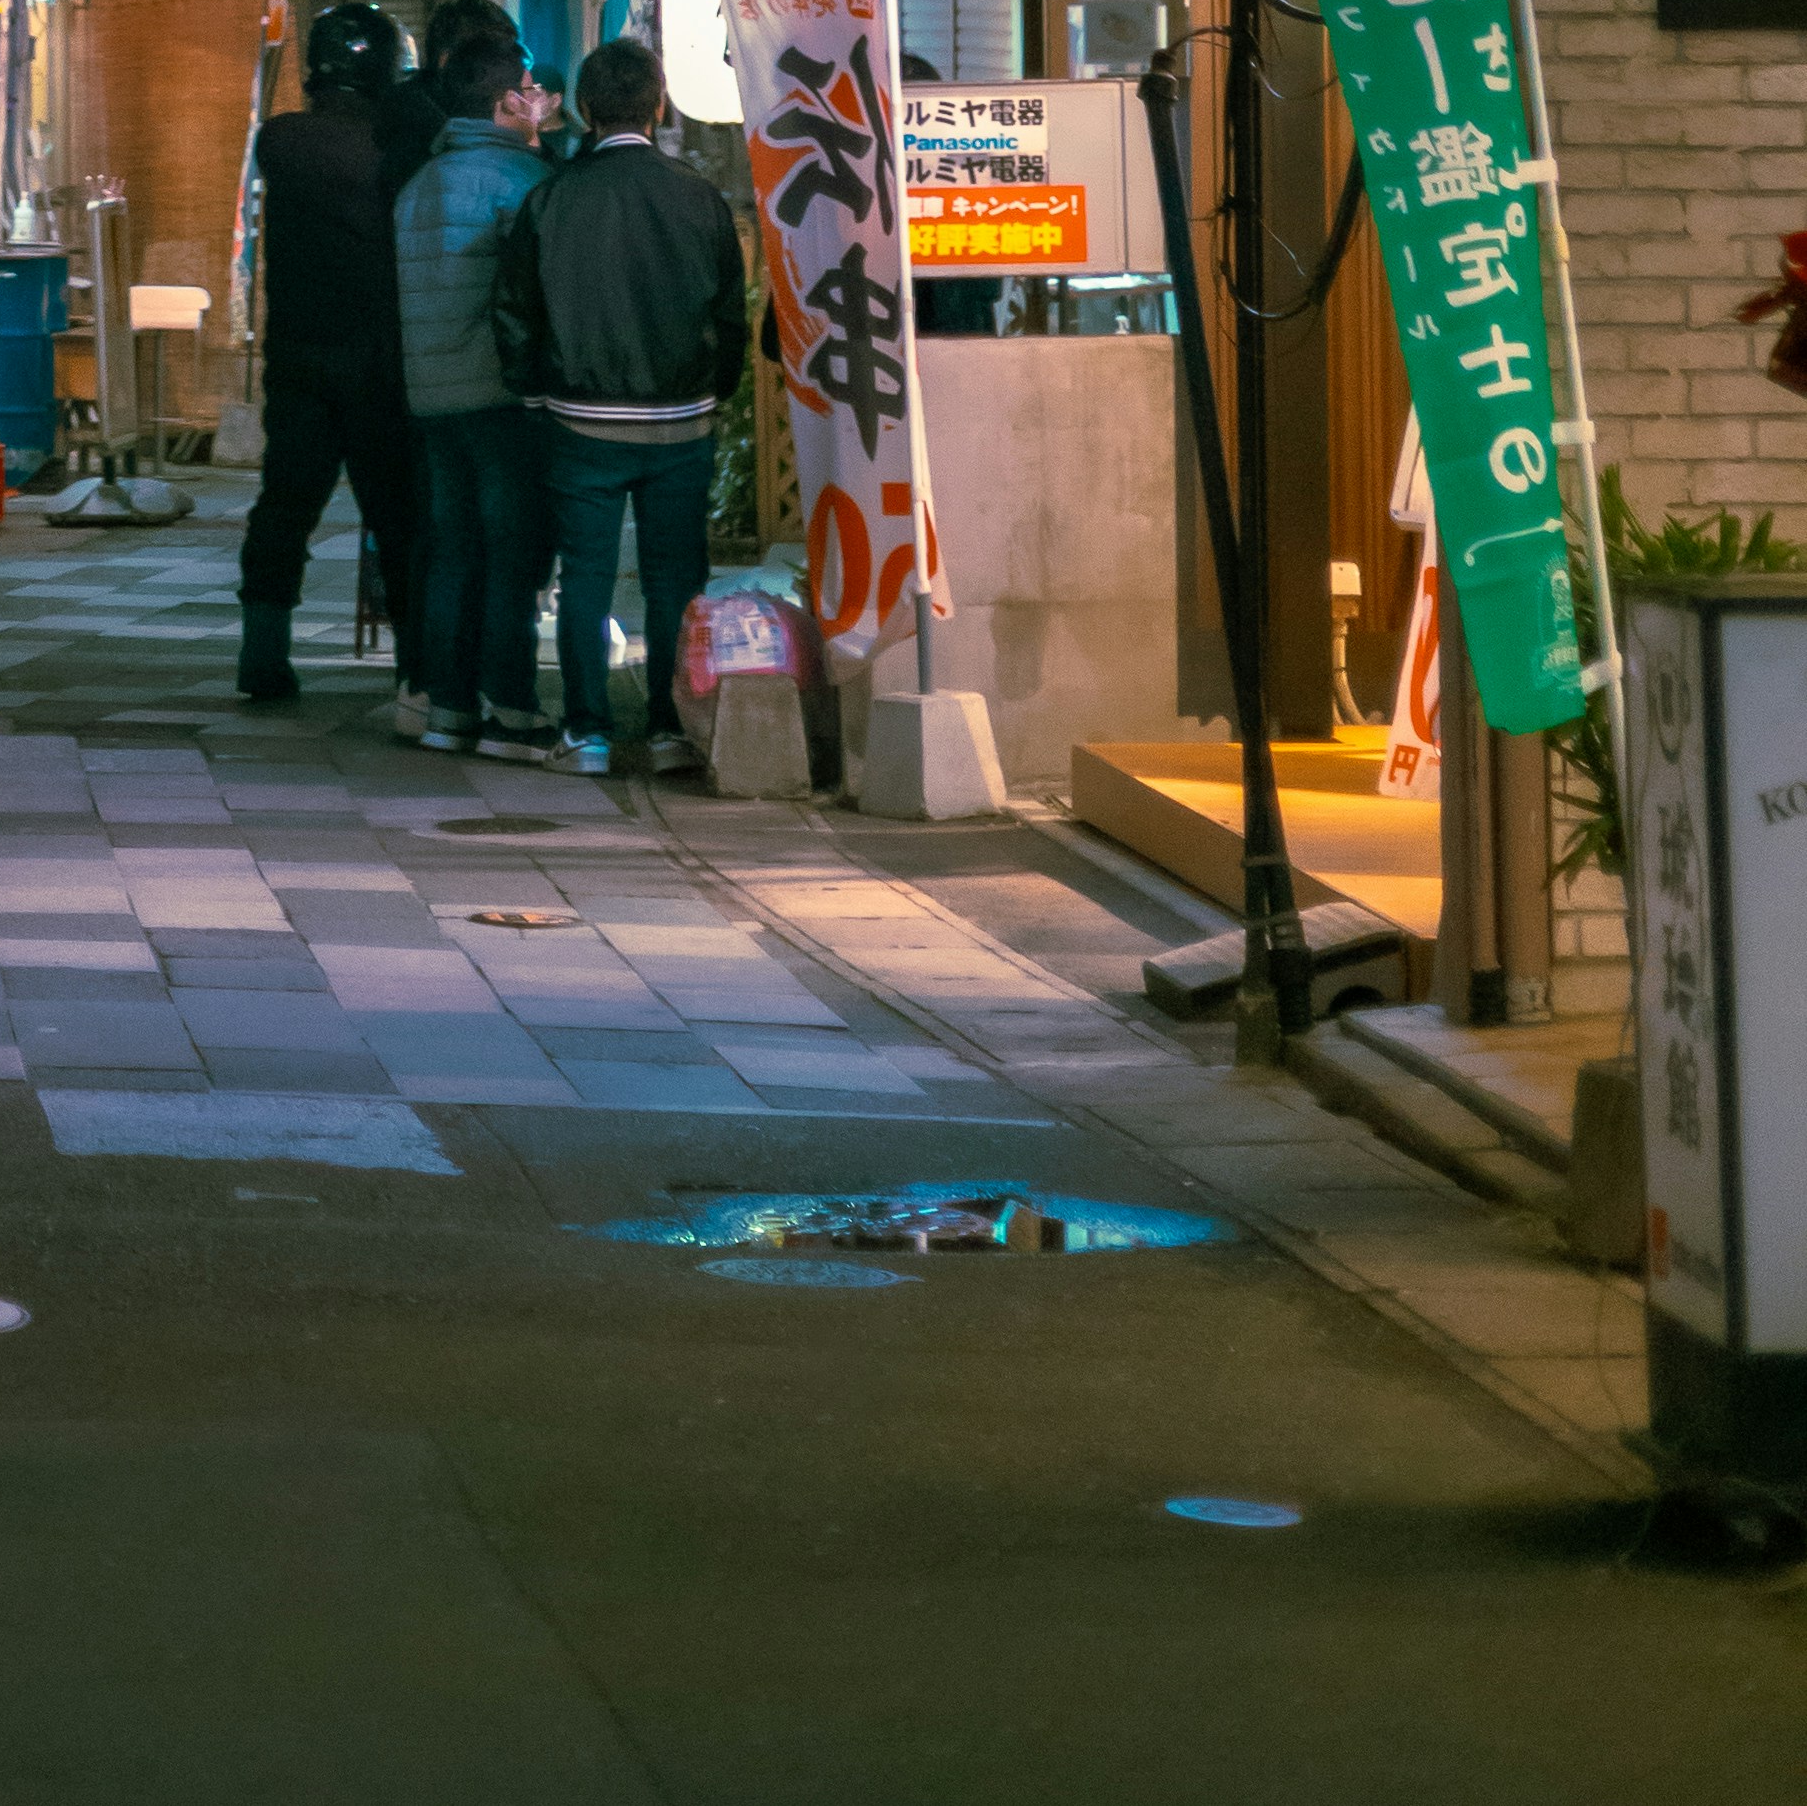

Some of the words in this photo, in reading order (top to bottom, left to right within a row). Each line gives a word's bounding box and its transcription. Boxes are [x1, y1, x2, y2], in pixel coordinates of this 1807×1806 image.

[904, 99, 1044, 127] ルミヤ電器
[904, 133, 1019, 151] Panasonic
[909, 221, 1063, 257] 好評実施中
